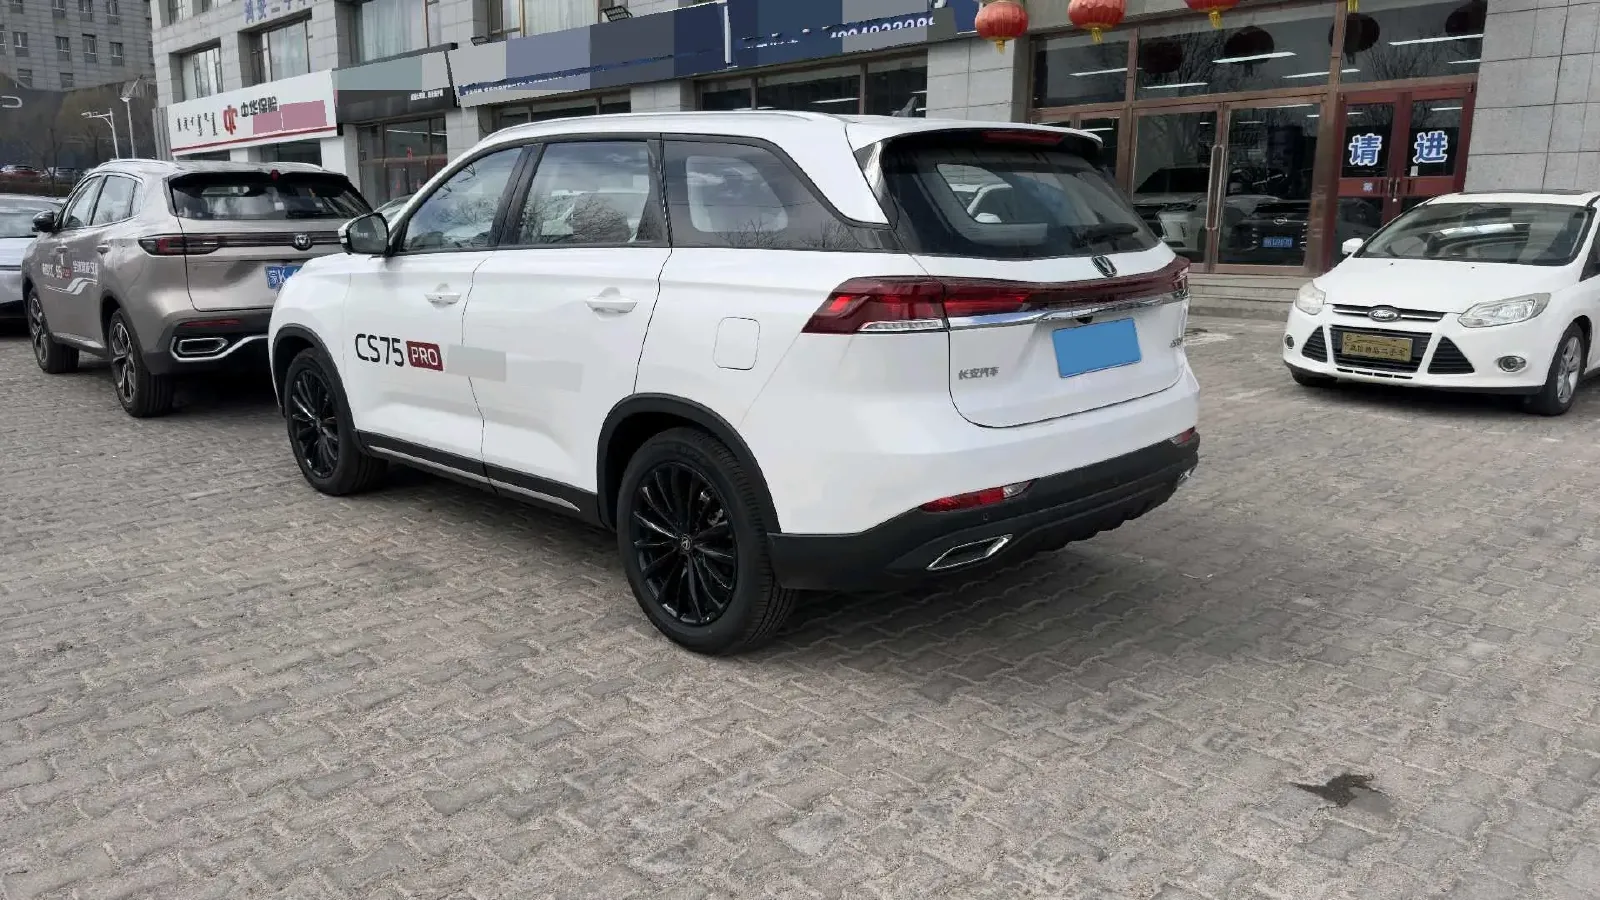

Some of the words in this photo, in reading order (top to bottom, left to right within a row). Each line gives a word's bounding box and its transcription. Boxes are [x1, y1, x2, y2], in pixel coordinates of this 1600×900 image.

[240, 96, 278, 118] 中华保险
[1347, 132, 1382, 166] 请
[1412, 130, 1448, 164] 进
[355, 333, 404, 367] CS75
[410, 346, 439, 366] PRO
[958, 366, 1000, 380] 长安汽车
